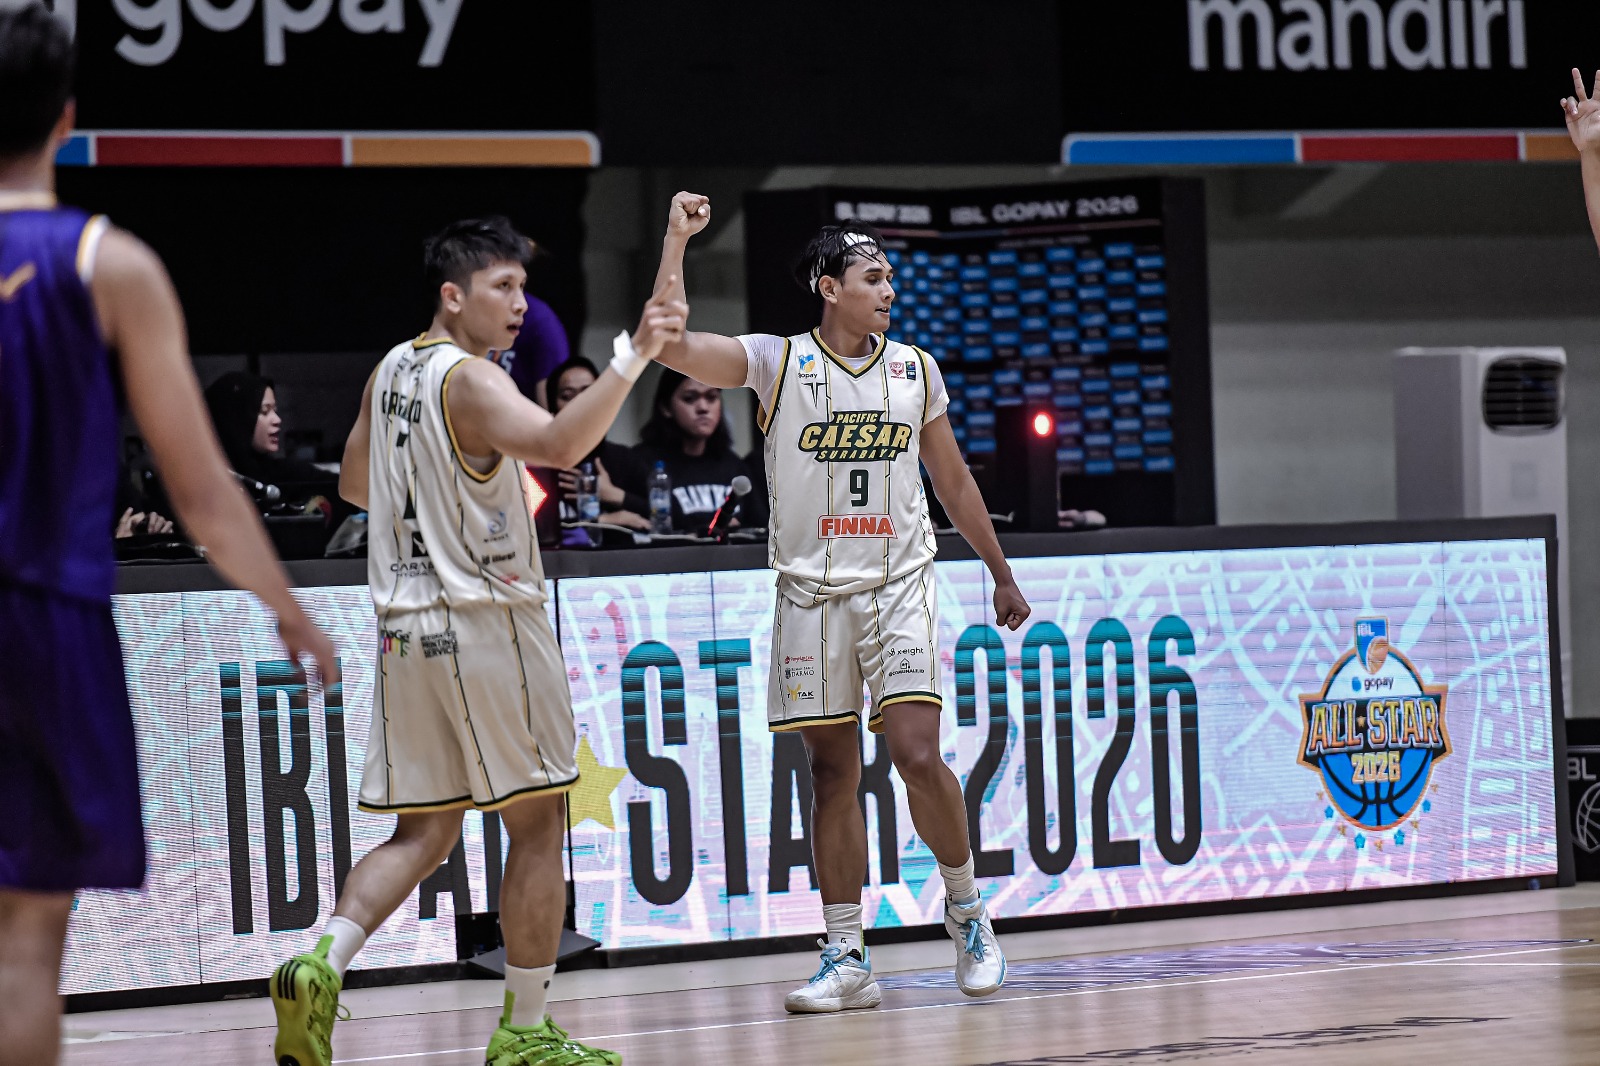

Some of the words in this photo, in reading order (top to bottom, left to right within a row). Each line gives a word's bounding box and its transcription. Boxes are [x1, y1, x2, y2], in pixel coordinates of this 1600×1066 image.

[1188, 0, 1528, 71] mandiri
[835, 411, 879, 423] PACIFIC
[801, 424, 911, 449] CAESAR
[818, 449, 897, 461] SURABAYA
[849, 469, 869, 507] 9
[821, 517, 893, 536] FINNA
[1364, 676, 1394, 691] gopay
[1309, 702, 1363, 753] ALL
[1368, 696, 1440, 748] STAR
[954, 614, 1201, 877] 2026
[1351, 750, 1401, 784] 2026
